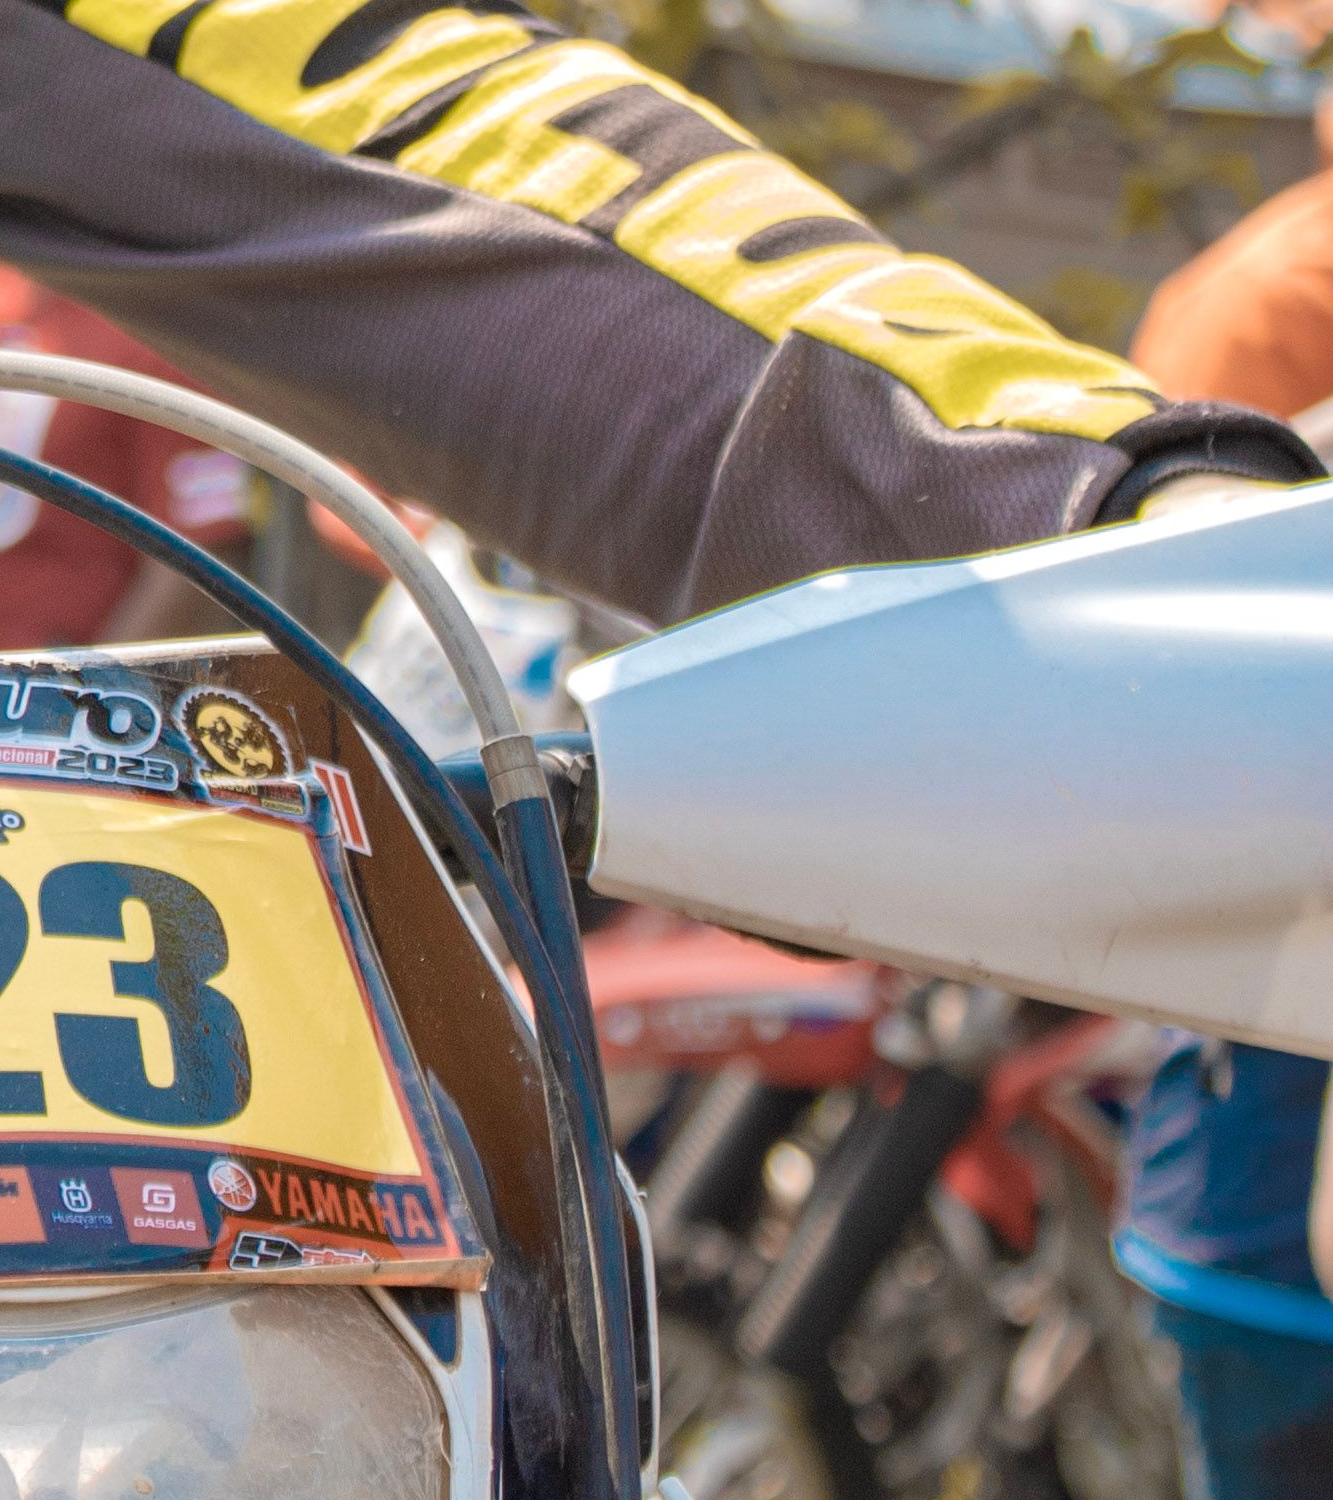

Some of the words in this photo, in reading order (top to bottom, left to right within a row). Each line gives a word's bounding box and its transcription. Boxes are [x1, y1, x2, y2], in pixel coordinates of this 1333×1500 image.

[55, 746, 177, 788] 2023
[257, 1166, 438, 1241] YAMAHA
[51, 1211, 113, 1226] Husqvarna
[134, 1216, 196, 1232] GASGAS
